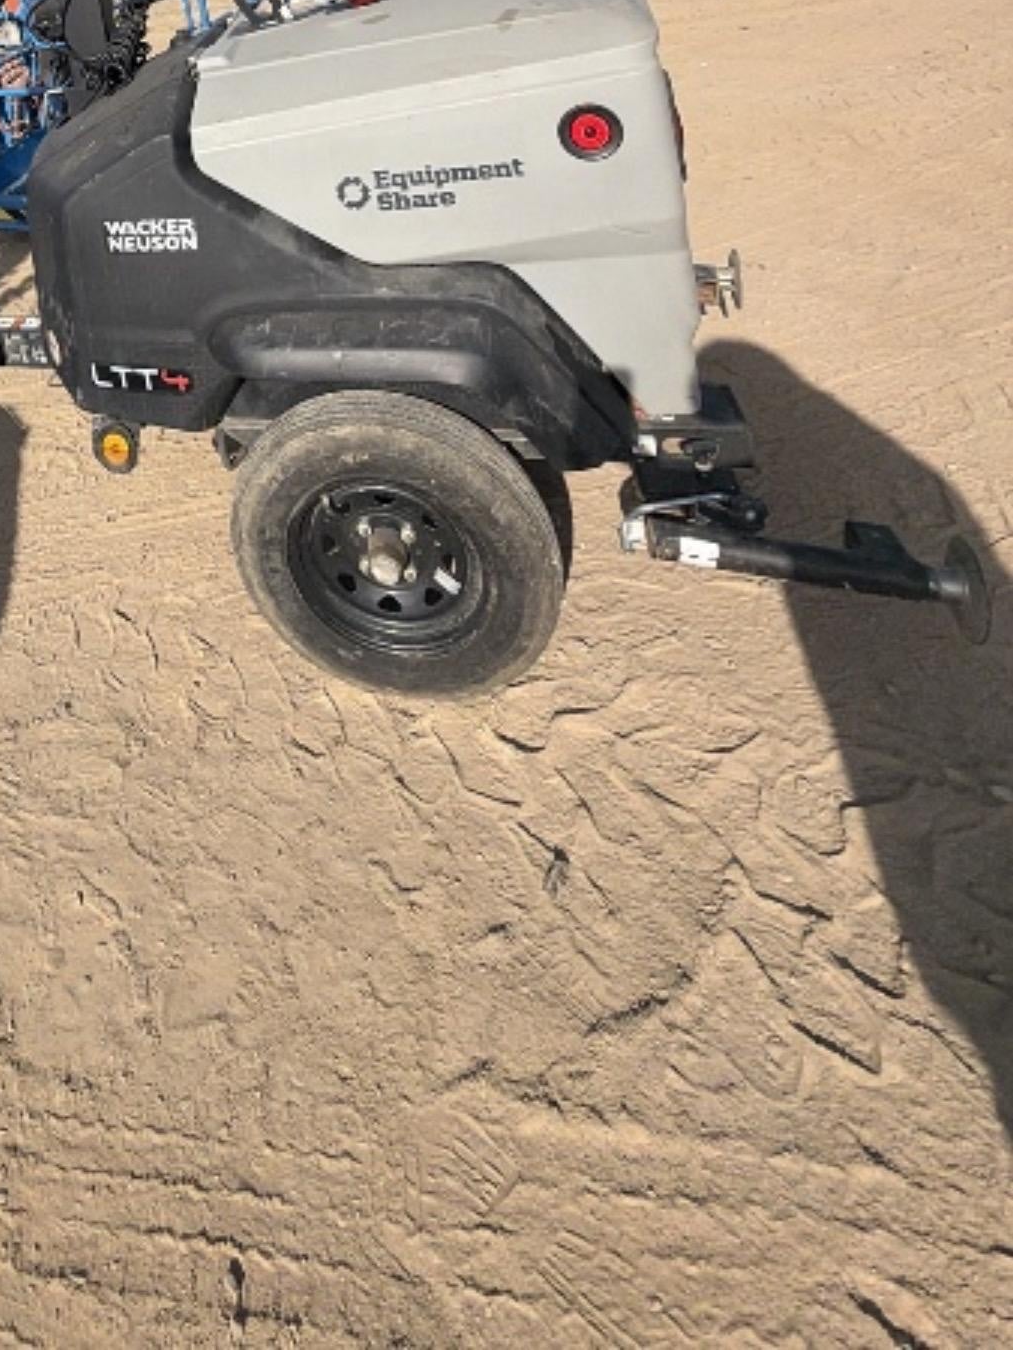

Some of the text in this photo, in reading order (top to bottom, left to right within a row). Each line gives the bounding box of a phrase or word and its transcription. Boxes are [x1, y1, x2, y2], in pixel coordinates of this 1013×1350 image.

[373, 158, 525, 191] Equipment
[376, 190, 457, 212] Share
[103, 217, 196, 237] WACKER
[107, 232, 198, 253] NEUSON
[90, 362, 189, 392] LTT4
